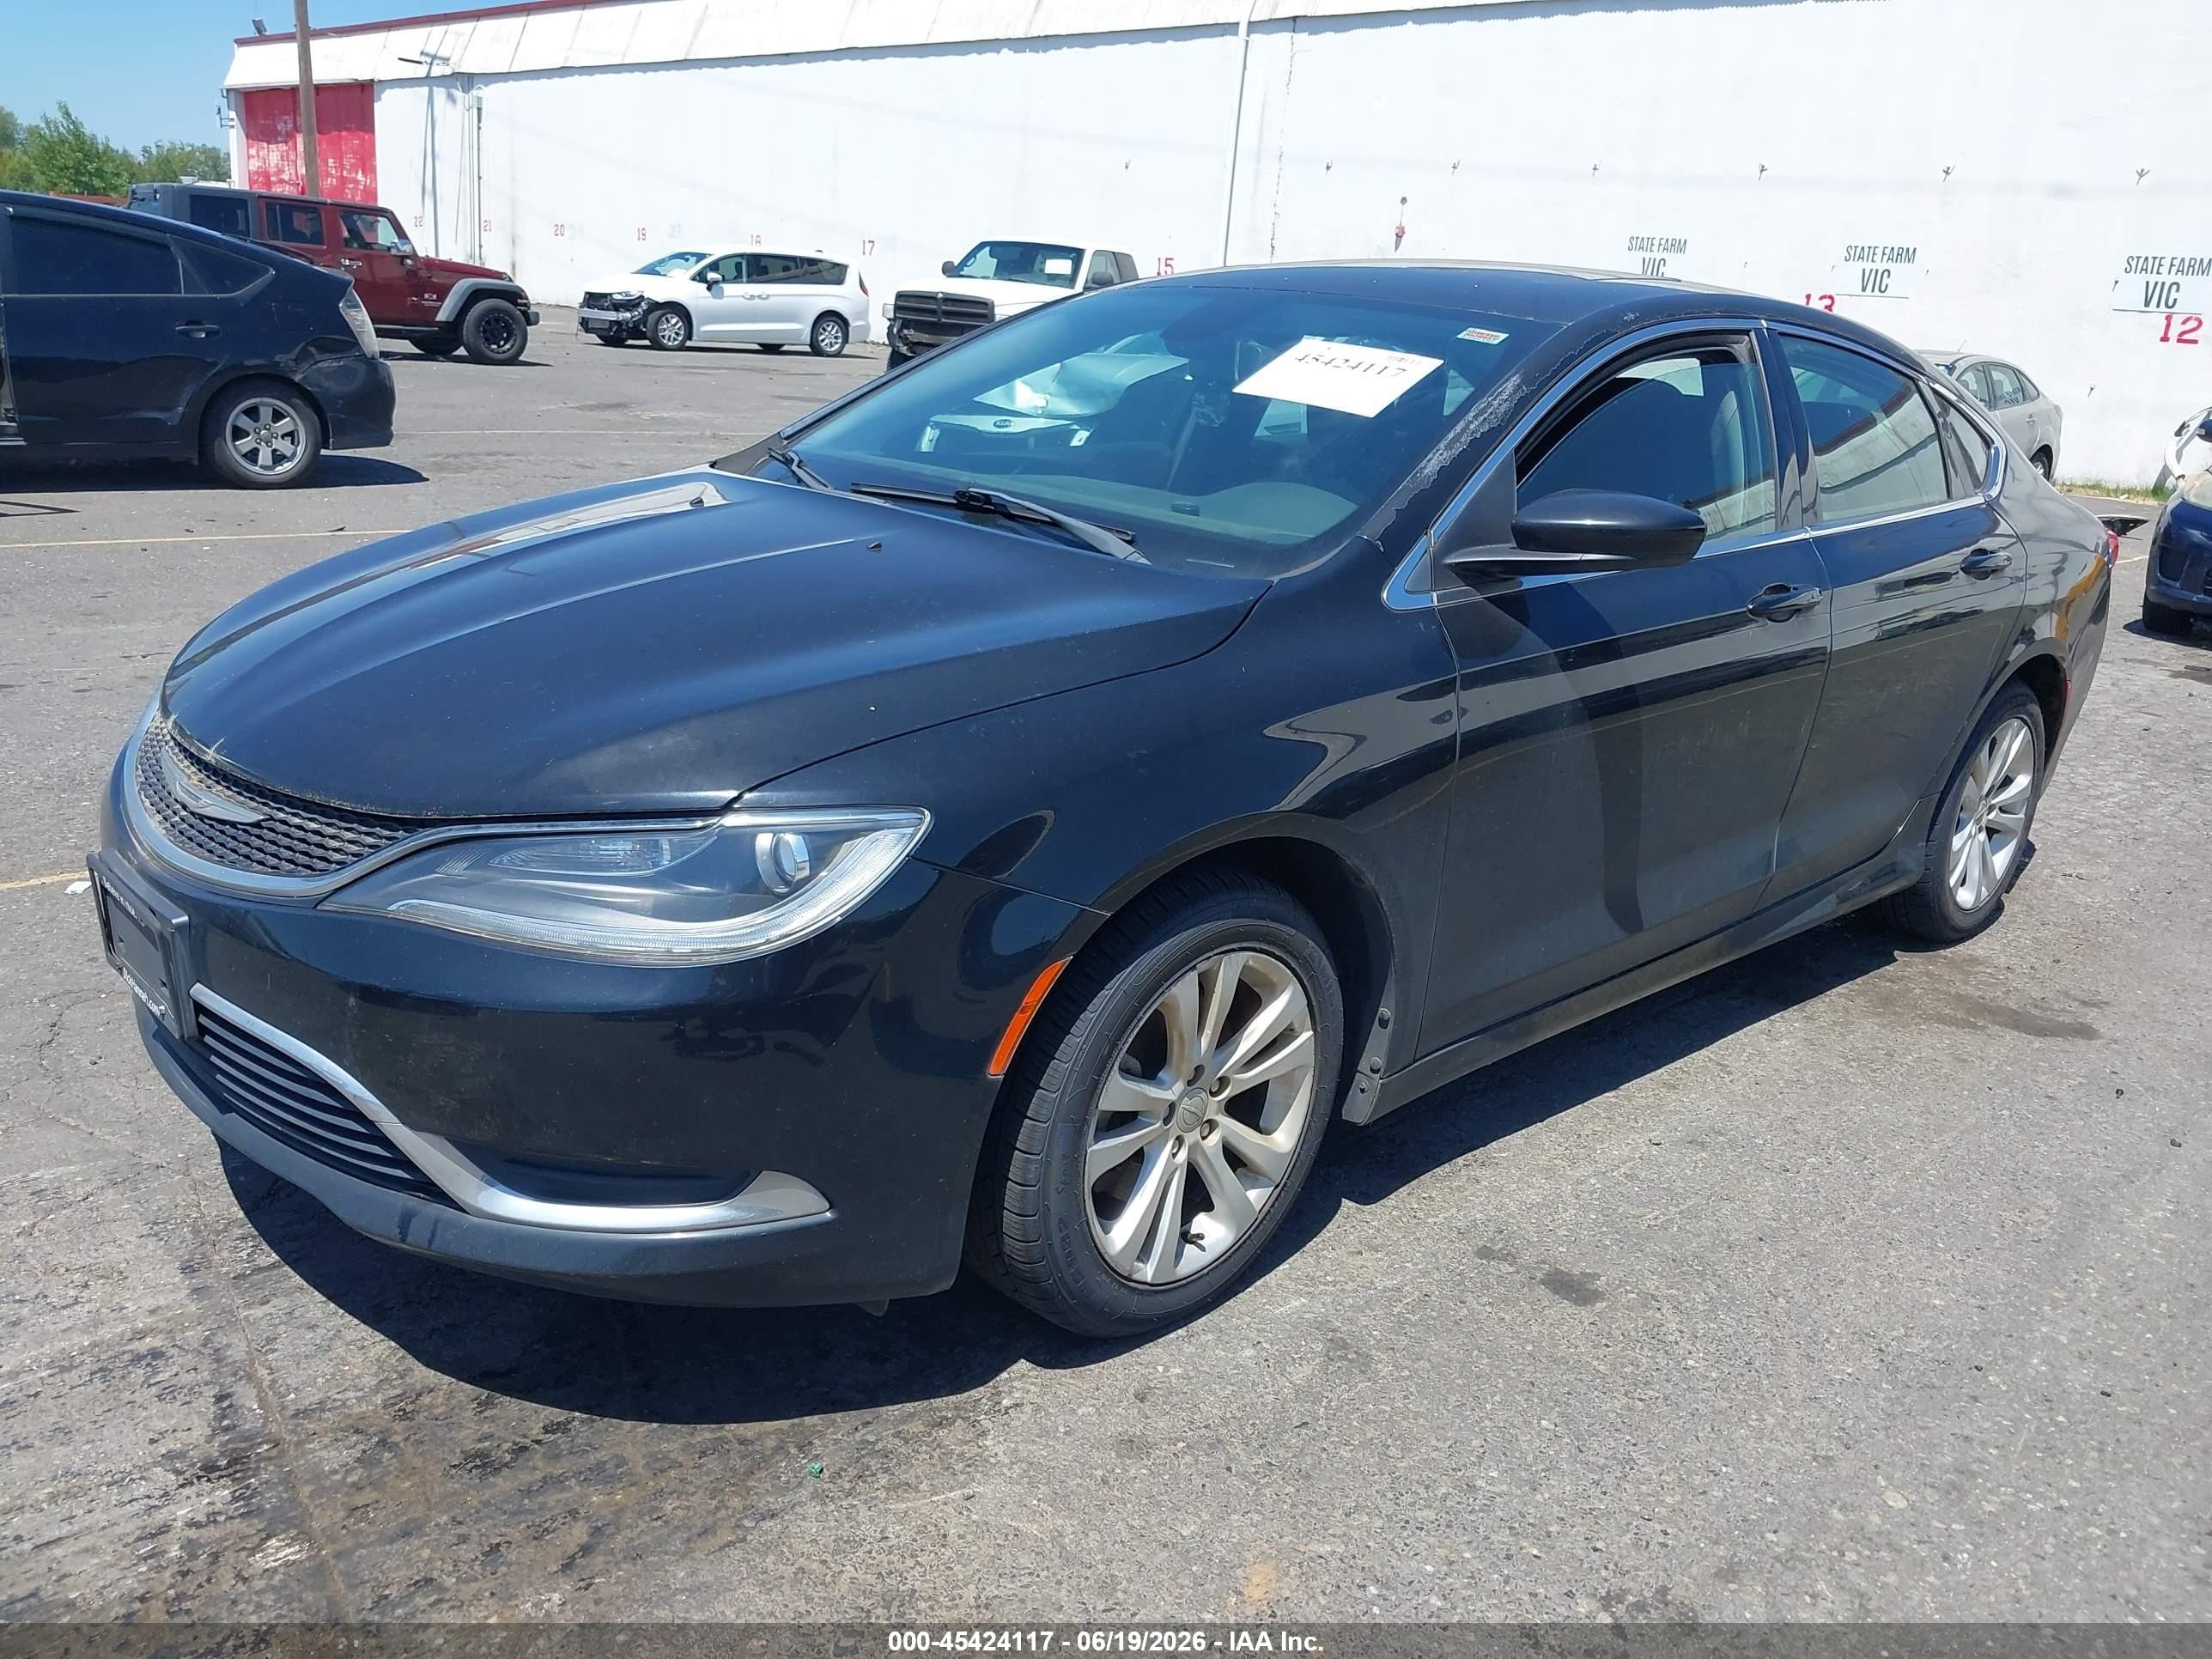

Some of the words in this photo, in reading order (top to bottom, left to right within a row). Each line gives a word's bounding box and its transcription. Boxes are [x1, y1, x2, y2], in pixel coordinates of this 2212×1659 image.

[554, 224, 565, 237] 20
[637, 228, 646, 240] 19
[862, 240, 874, 256] 17
[1628, 236, 1656, 252] STATE
[1657, 238, 1687, 254] FARM
[1844, 245, 1879, 263] STATE
[1880, 246, 1917, 264] FARM
[1157, 257, 1174, 276] 15
[1642, 257, 1667, 277] VIC
[2124, 255, 2166, 275] STATE
[2168, 257, 2212, 276] FARM
[1861, 268, 1891, 294] VIC
[2144, 280, 2180, 309] VIC
[2160, 314, 2203, 344] 12
